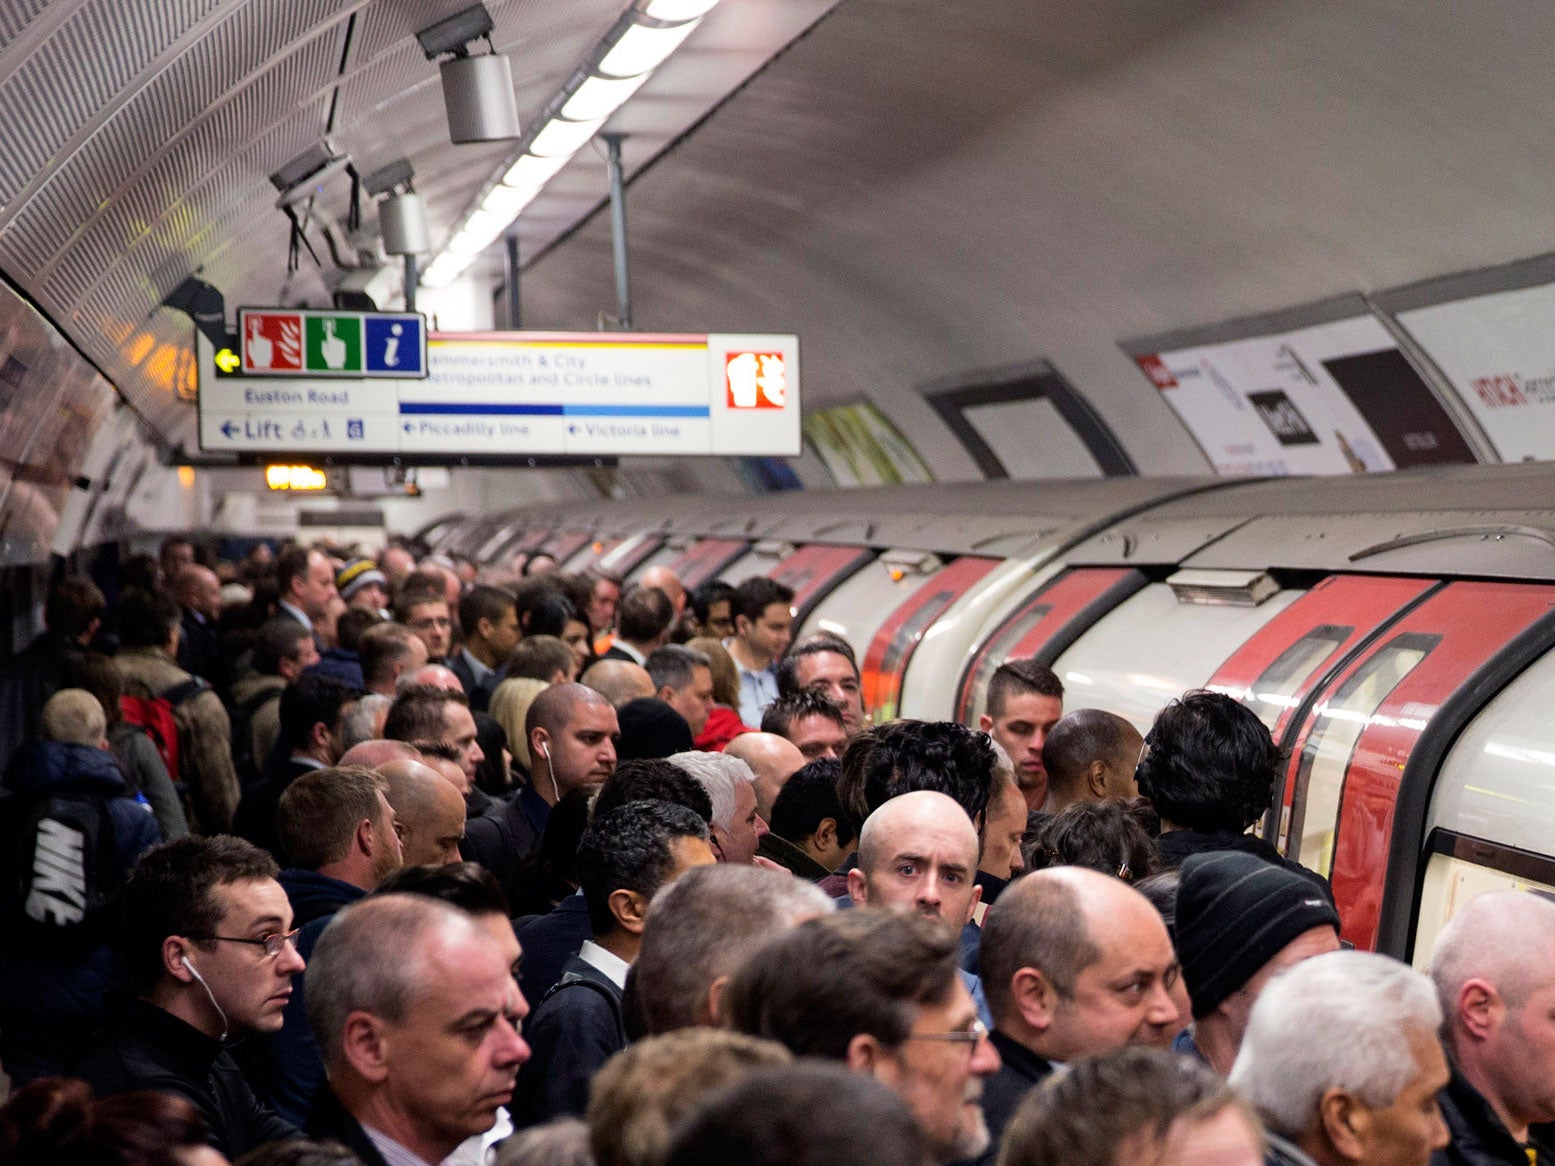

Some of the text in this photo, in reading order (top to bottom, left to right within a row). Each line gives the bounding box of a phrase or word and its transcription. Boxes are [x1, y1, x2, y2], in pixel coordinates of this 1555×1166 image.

[429, 353, 532, 368] ammersmith
[427, 372, 523, 388] etropolitan
[244, 388, 349, 404] Euston Road
[244, 418, 284, 439] Lift
[419, 420, 495, 438] Piccadilly
[586, 422, 647, 437] Victoria
[25, 817, 86, 926] NIKE
